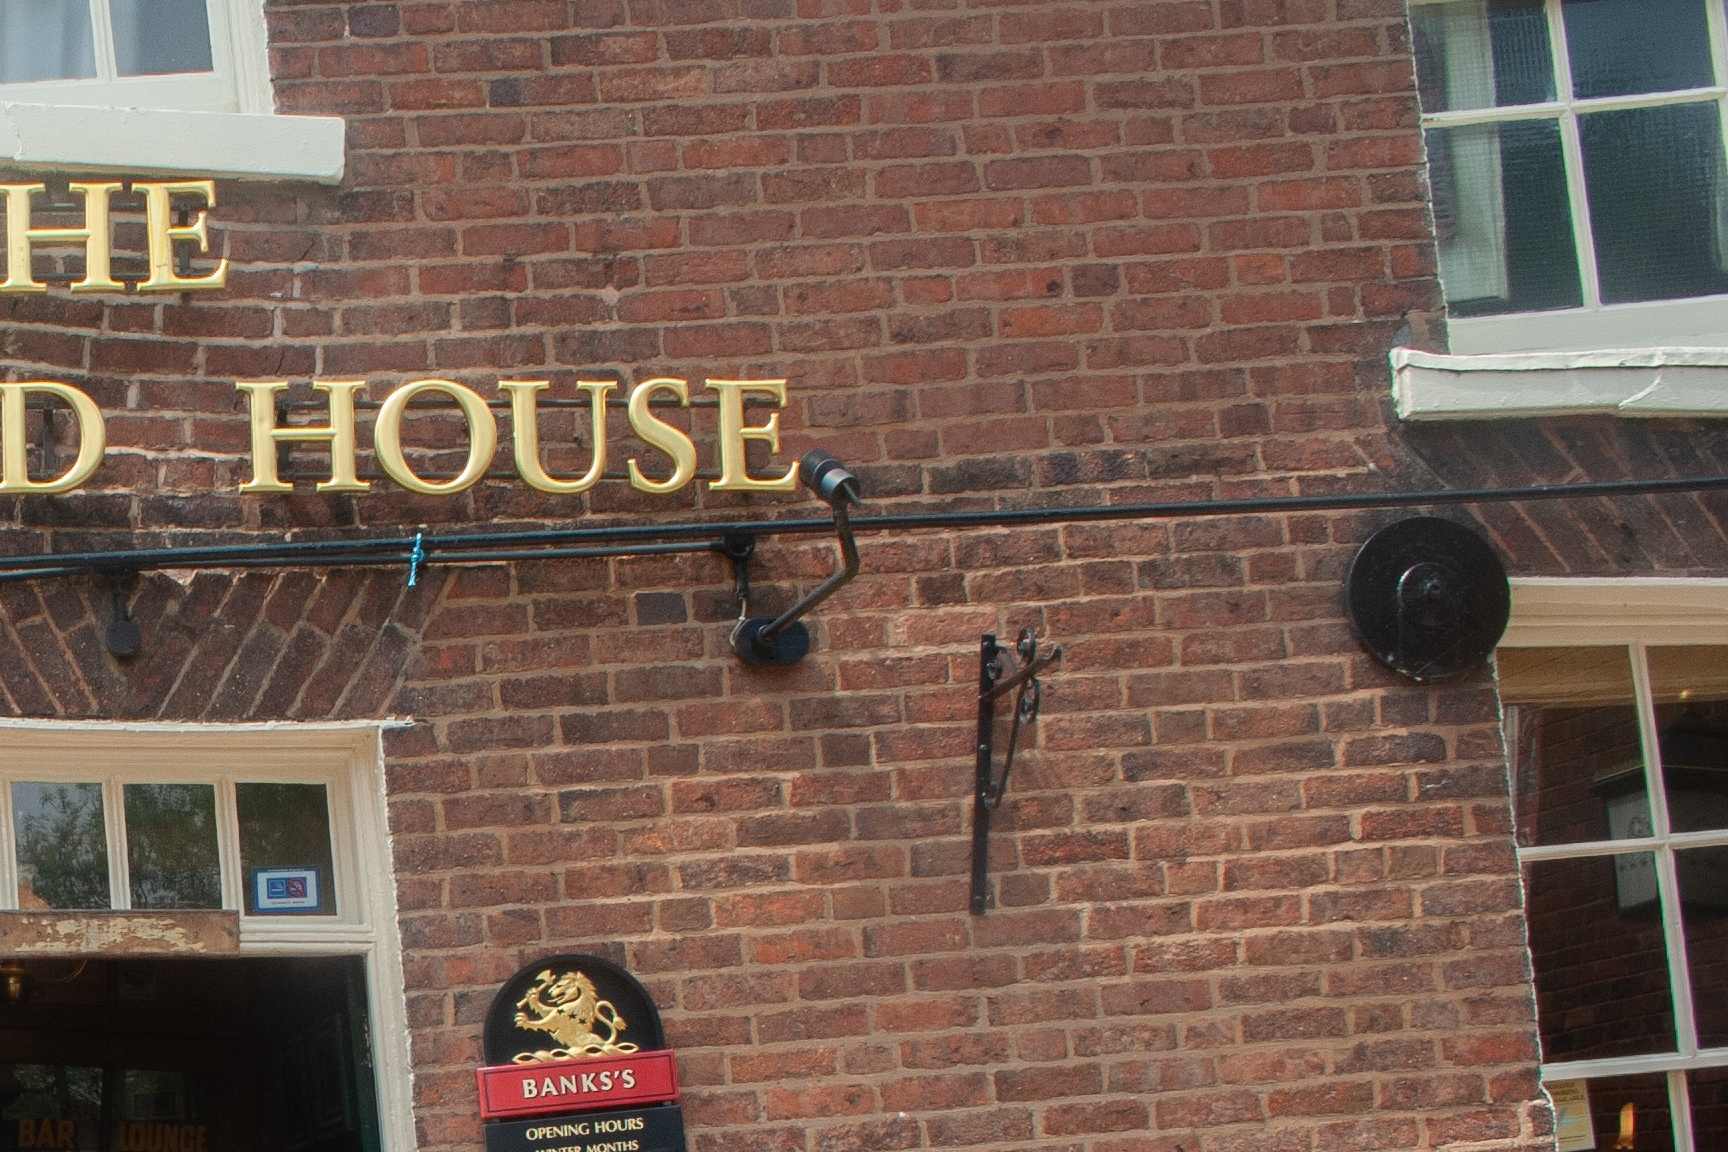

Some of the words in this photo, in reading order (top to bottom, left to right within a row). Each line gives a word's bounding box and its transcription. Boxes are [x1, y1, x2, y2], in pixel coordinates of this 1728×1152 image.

[236, 377, 800, 496] HOUSE
[521, 1068, 636, 1099] BANKS'S
[18, 1117, 78, 1150] BAR
[525, 1122, 591, 1141] OPENING
[594, 1116, 645, 1134] HOURS
